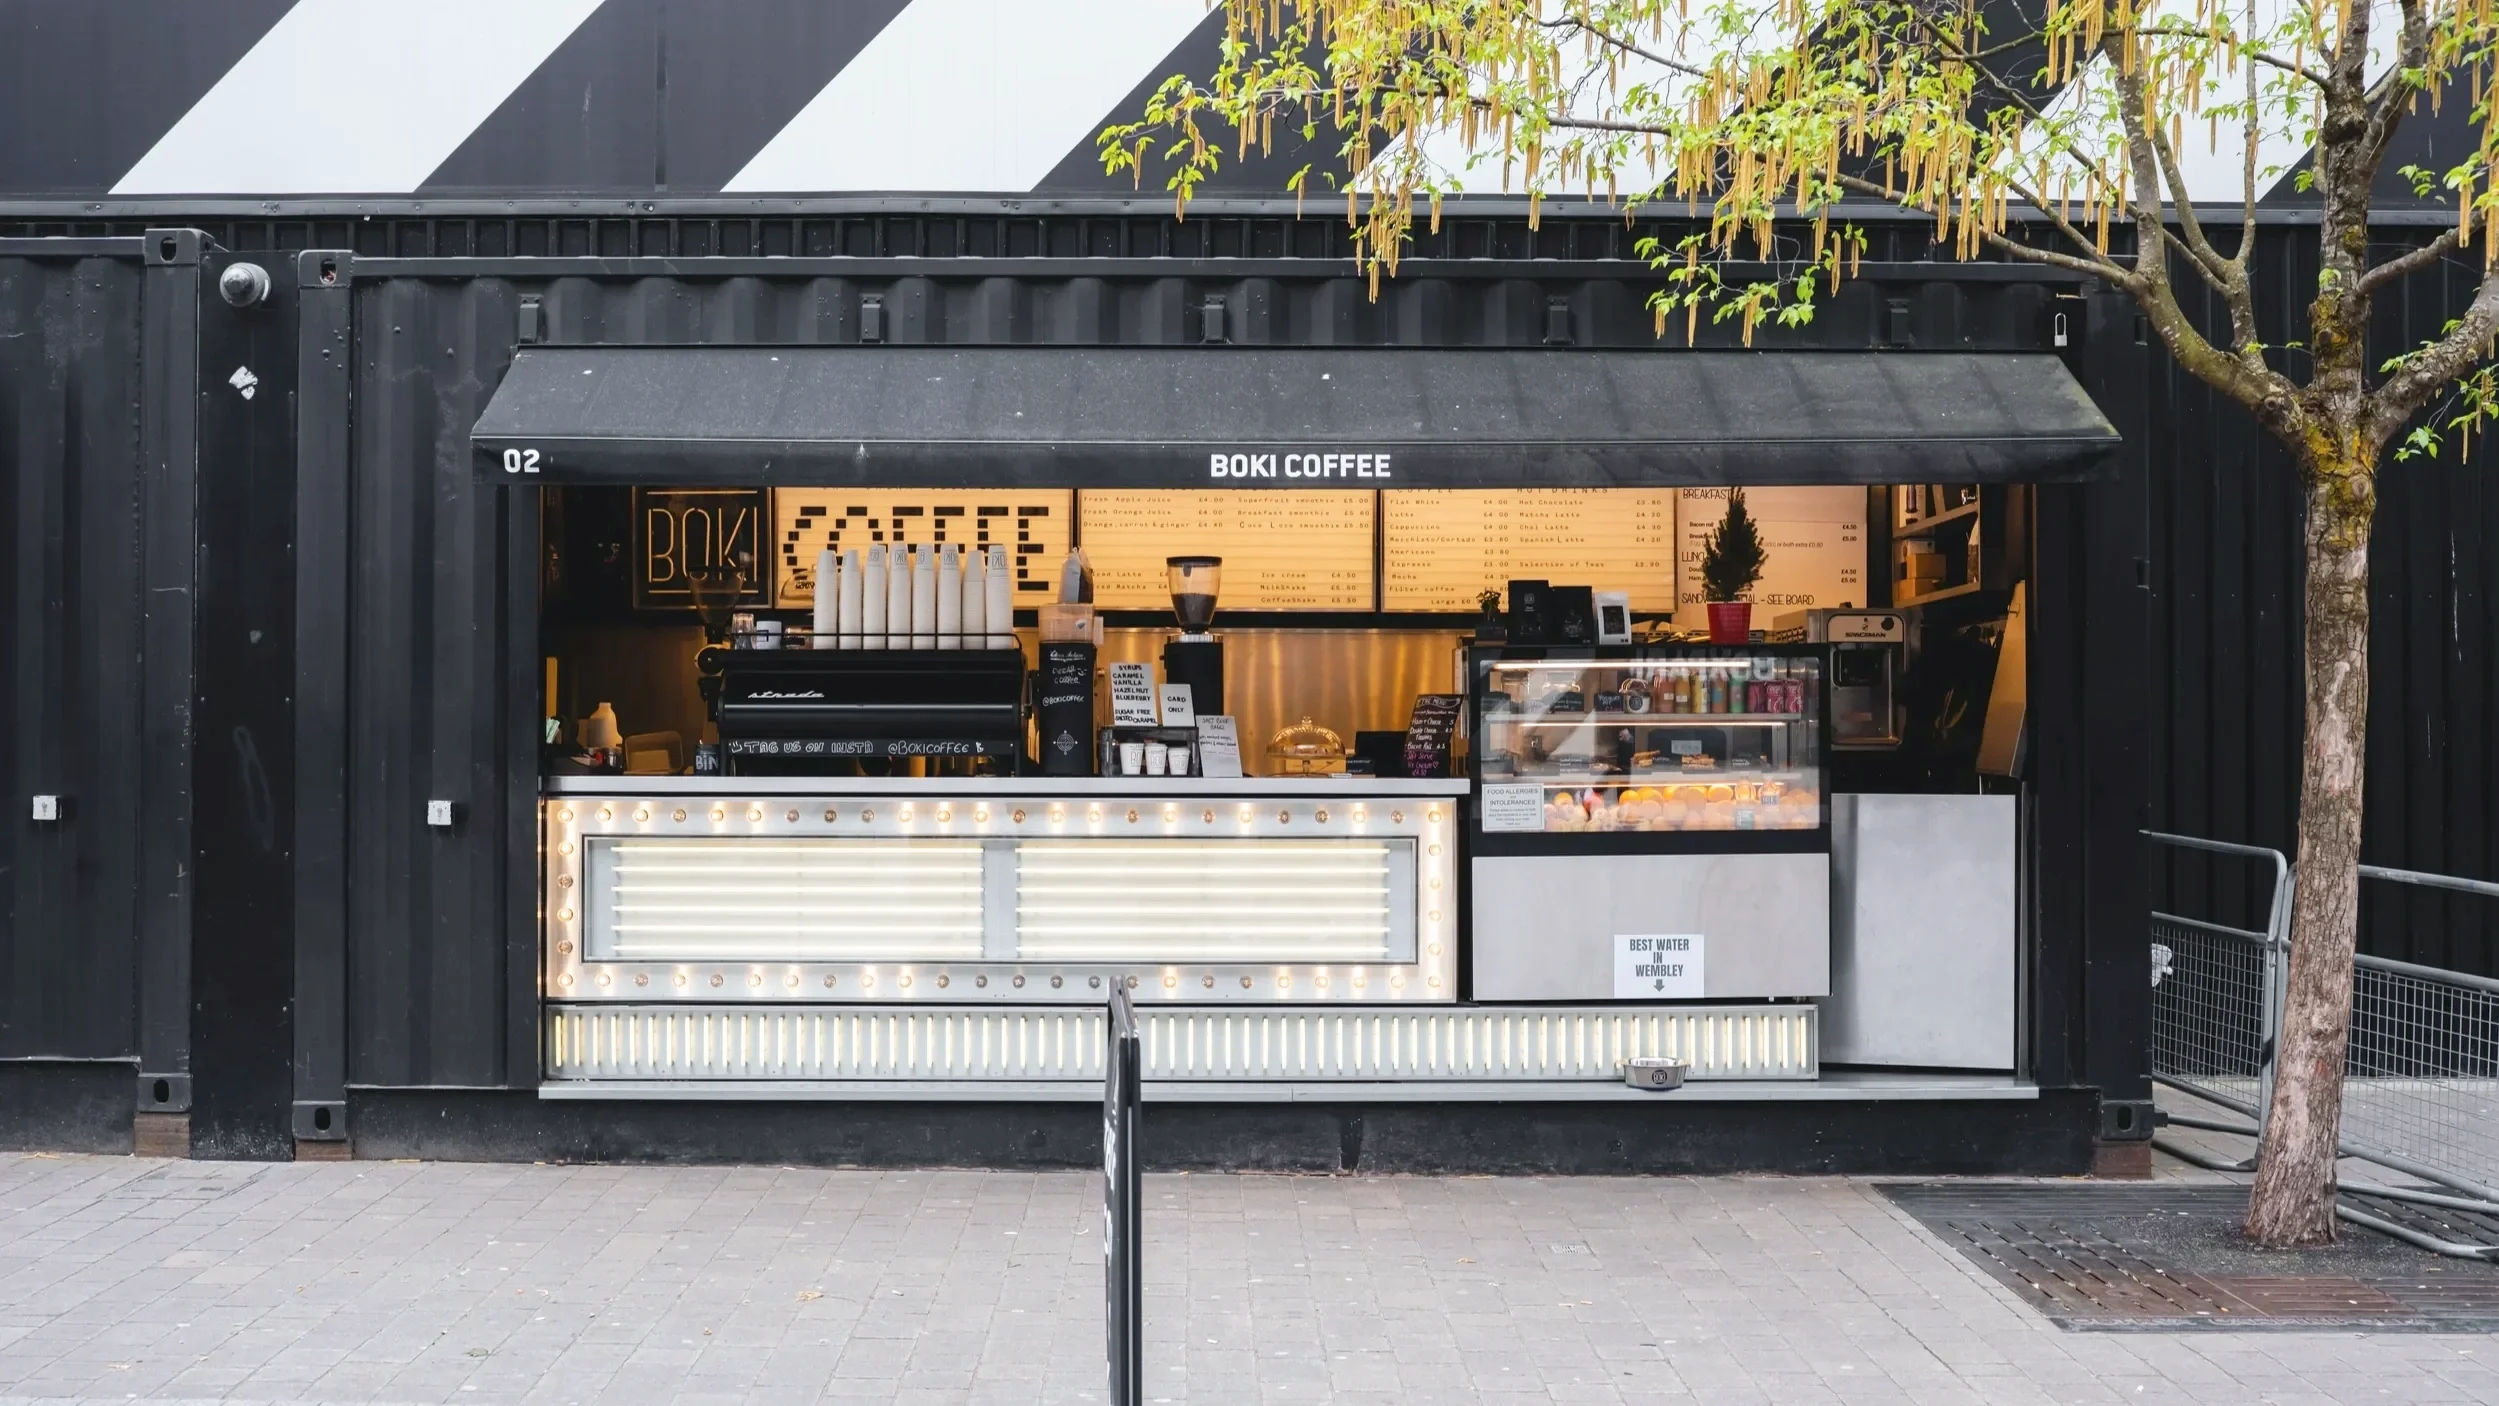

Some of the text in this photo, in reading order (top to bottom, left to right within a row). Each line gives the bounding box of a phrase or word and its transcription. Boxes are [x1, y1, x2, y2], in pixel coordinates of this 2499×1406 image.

[503, 449, 540, 473] 02
[1211, 454, 1391, 477] BOKI COFFEE
[1682, 489, 1731, 500] BREAKFAST
[648, 507, 758, 583] BOKI
[1767, 594, 1784, 605] SEE
[1786, 595, 1814, 605] BOARD
[748, 690, 825, 698] strada
[744, 741, 778, 754] TAG
[784, 741, 801, 753] US
[805, 741, 825, 753] ON
[831, 741, 874, 754] INSTA
[1629, 938, 1689, 951] BEST WATER
[1653, 952, 1662, 964] IN
[1635, 964, 1684, 977] WEMBLEY
